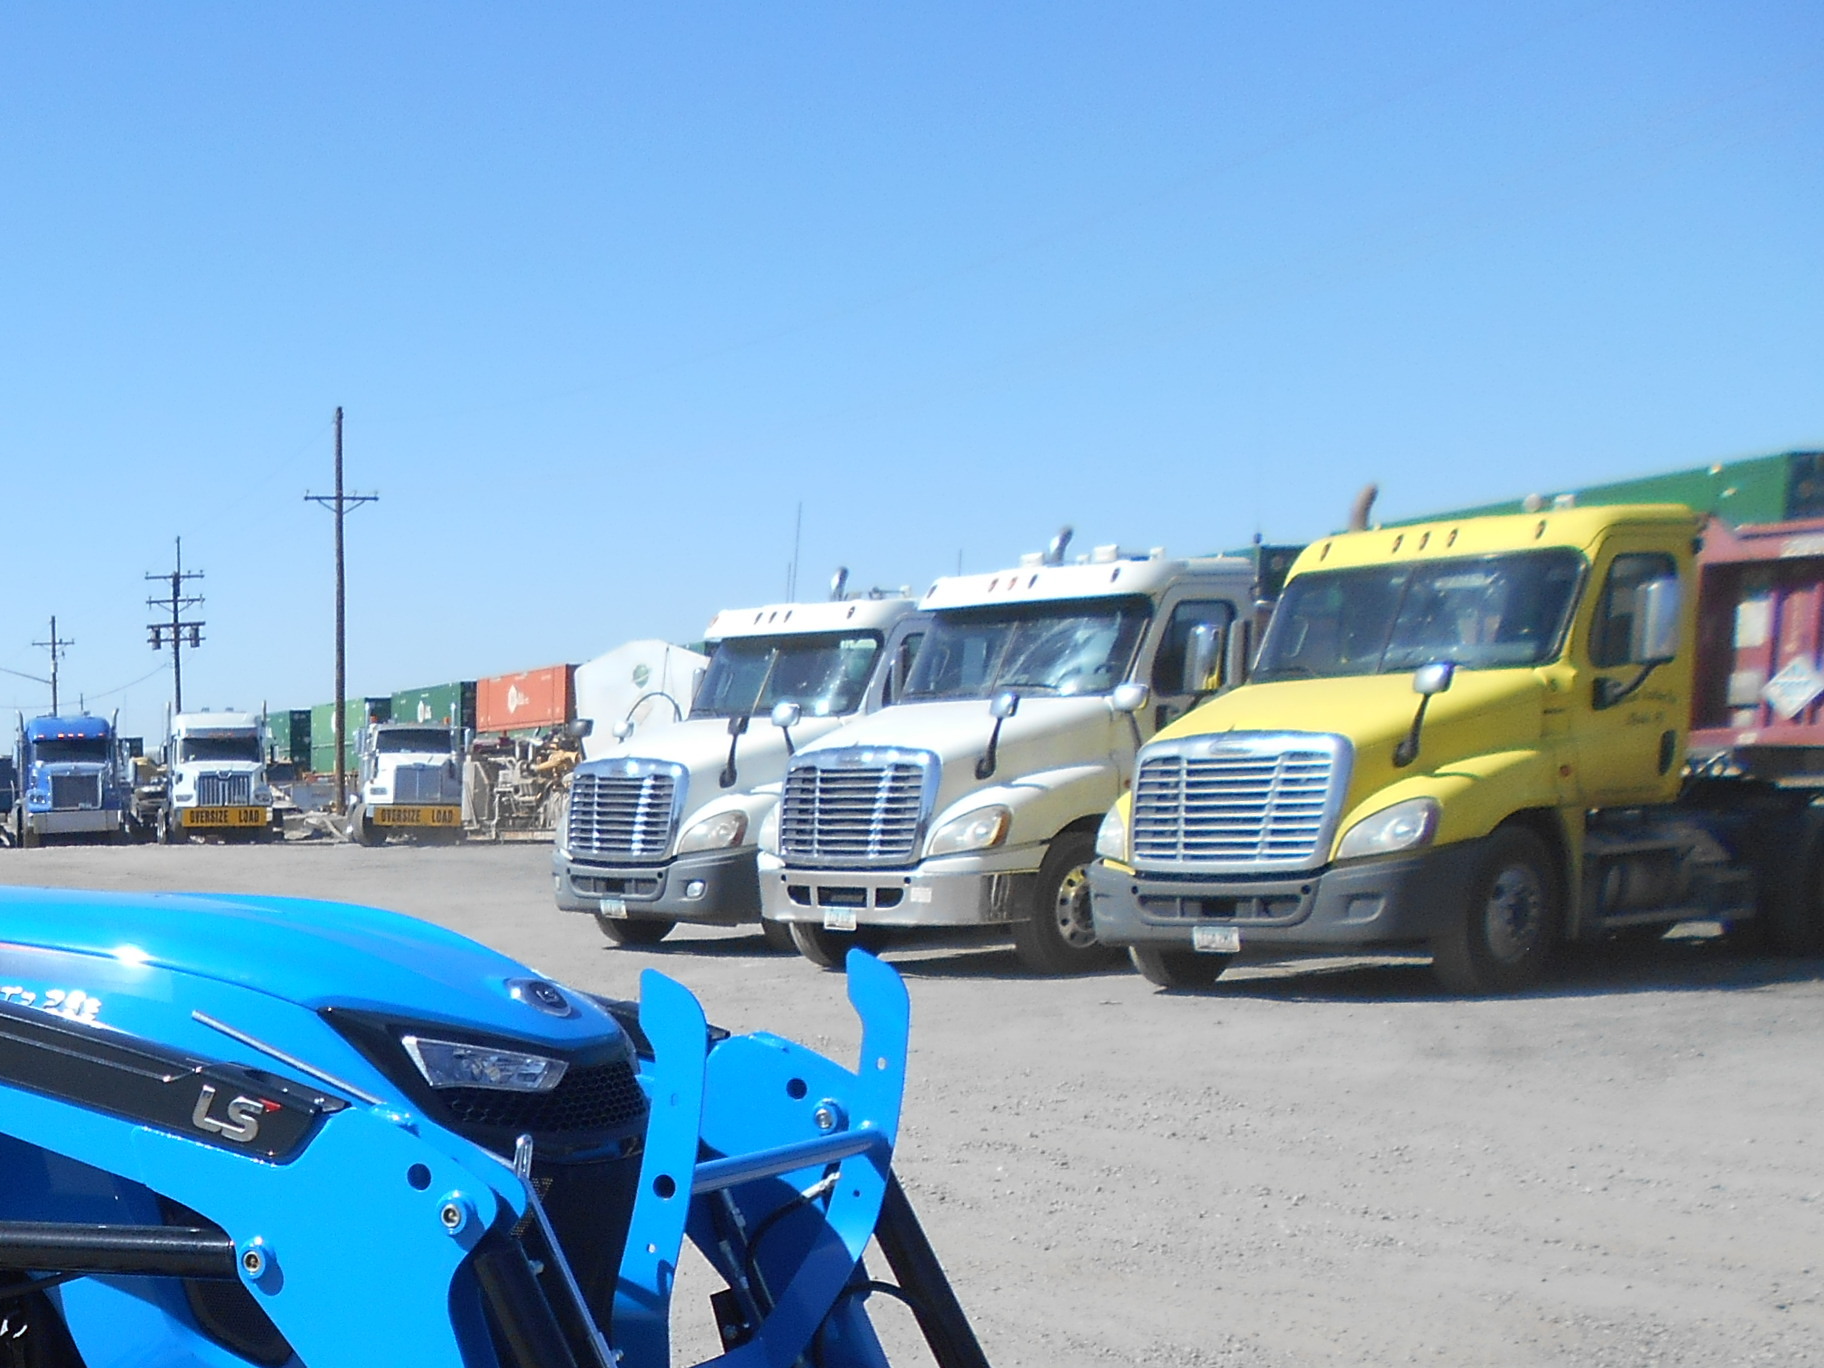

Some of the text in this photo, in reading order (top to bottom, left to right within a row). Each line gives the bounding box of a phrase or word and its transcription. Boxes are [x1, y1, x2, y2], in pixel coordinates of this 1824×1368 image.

[190, 809, 260, 824] OVERSIZE LOAD
[381, 808, 453, 823] OVERSIZE LOAD
[192, 1084, 265, 1142] LS
